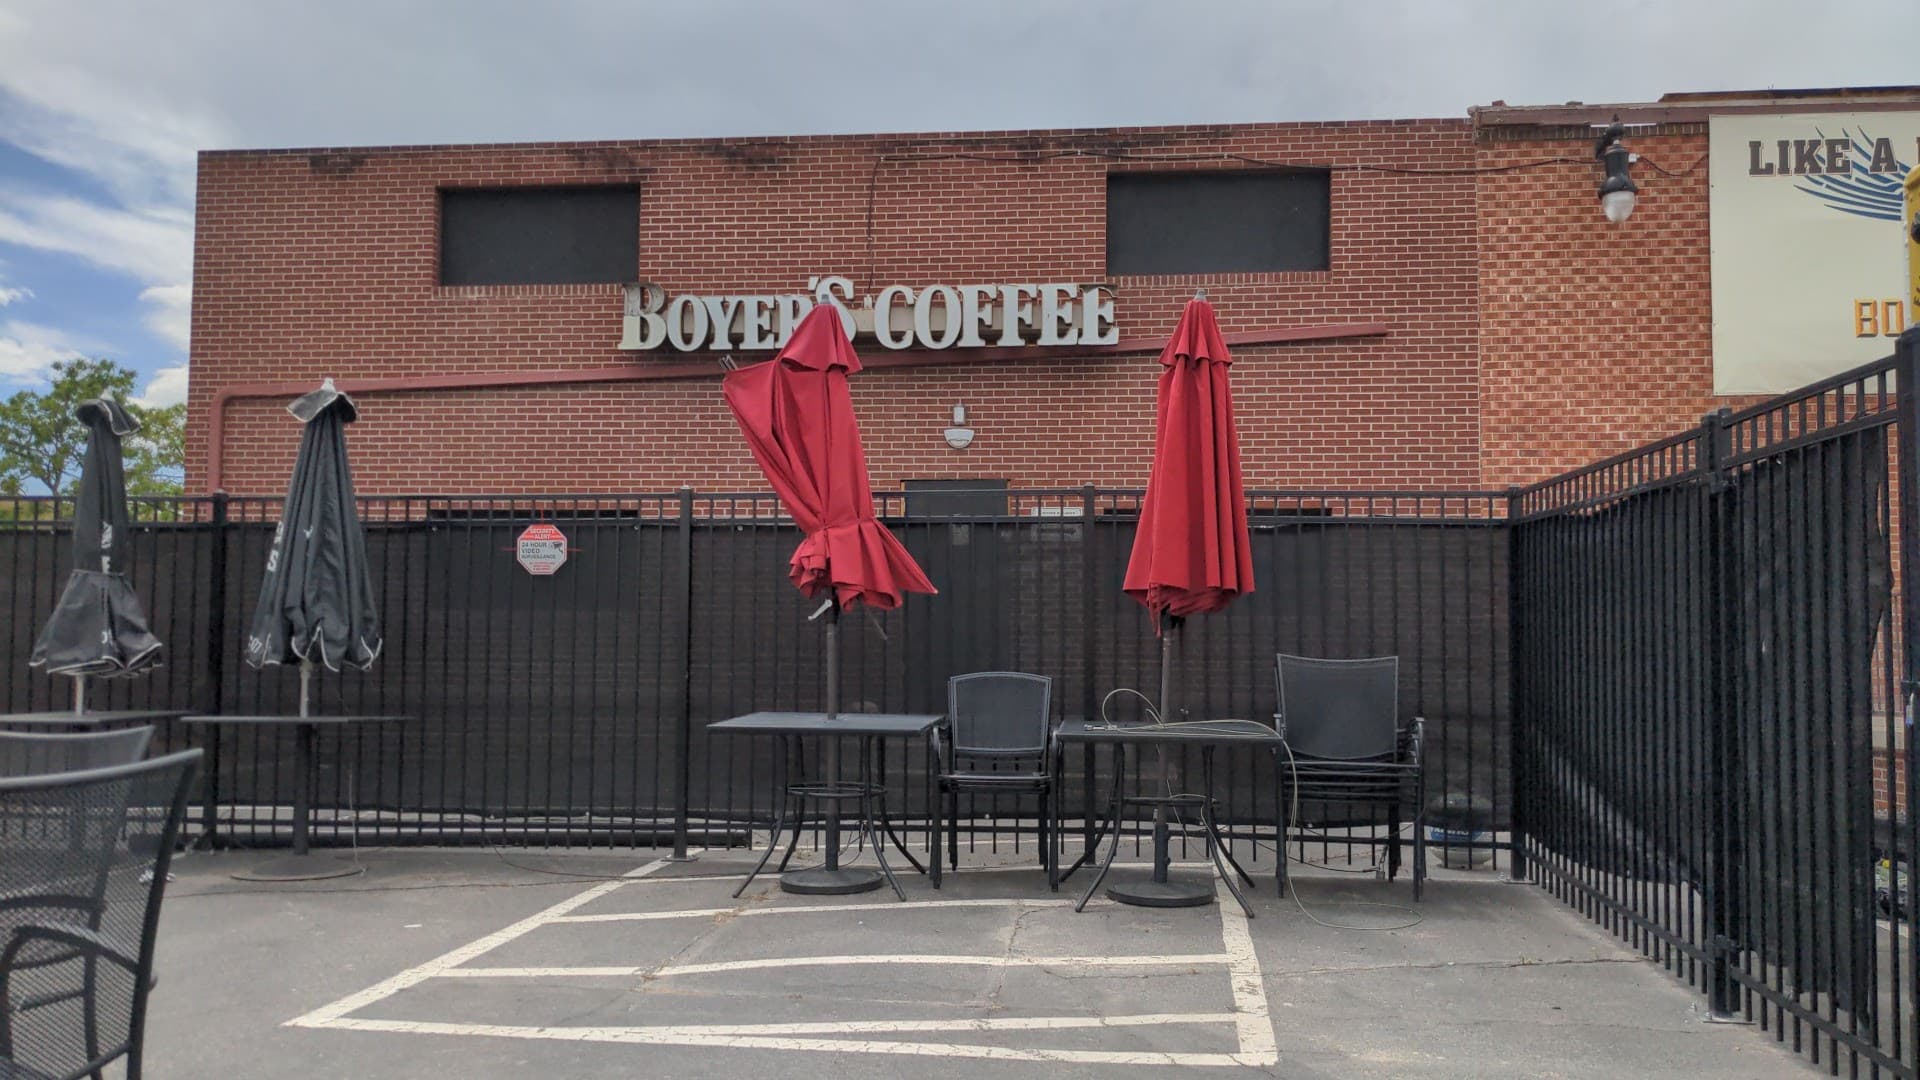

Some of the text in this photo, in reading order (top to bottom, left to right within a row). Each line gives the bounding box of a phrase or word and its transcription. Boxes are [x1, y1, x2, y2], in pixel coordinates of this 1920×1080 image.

[1749, 138, 1852, 175] LIKE
[1869, 137, 1899, 174] A
[874, 284, 1120, 350] COFFEE
